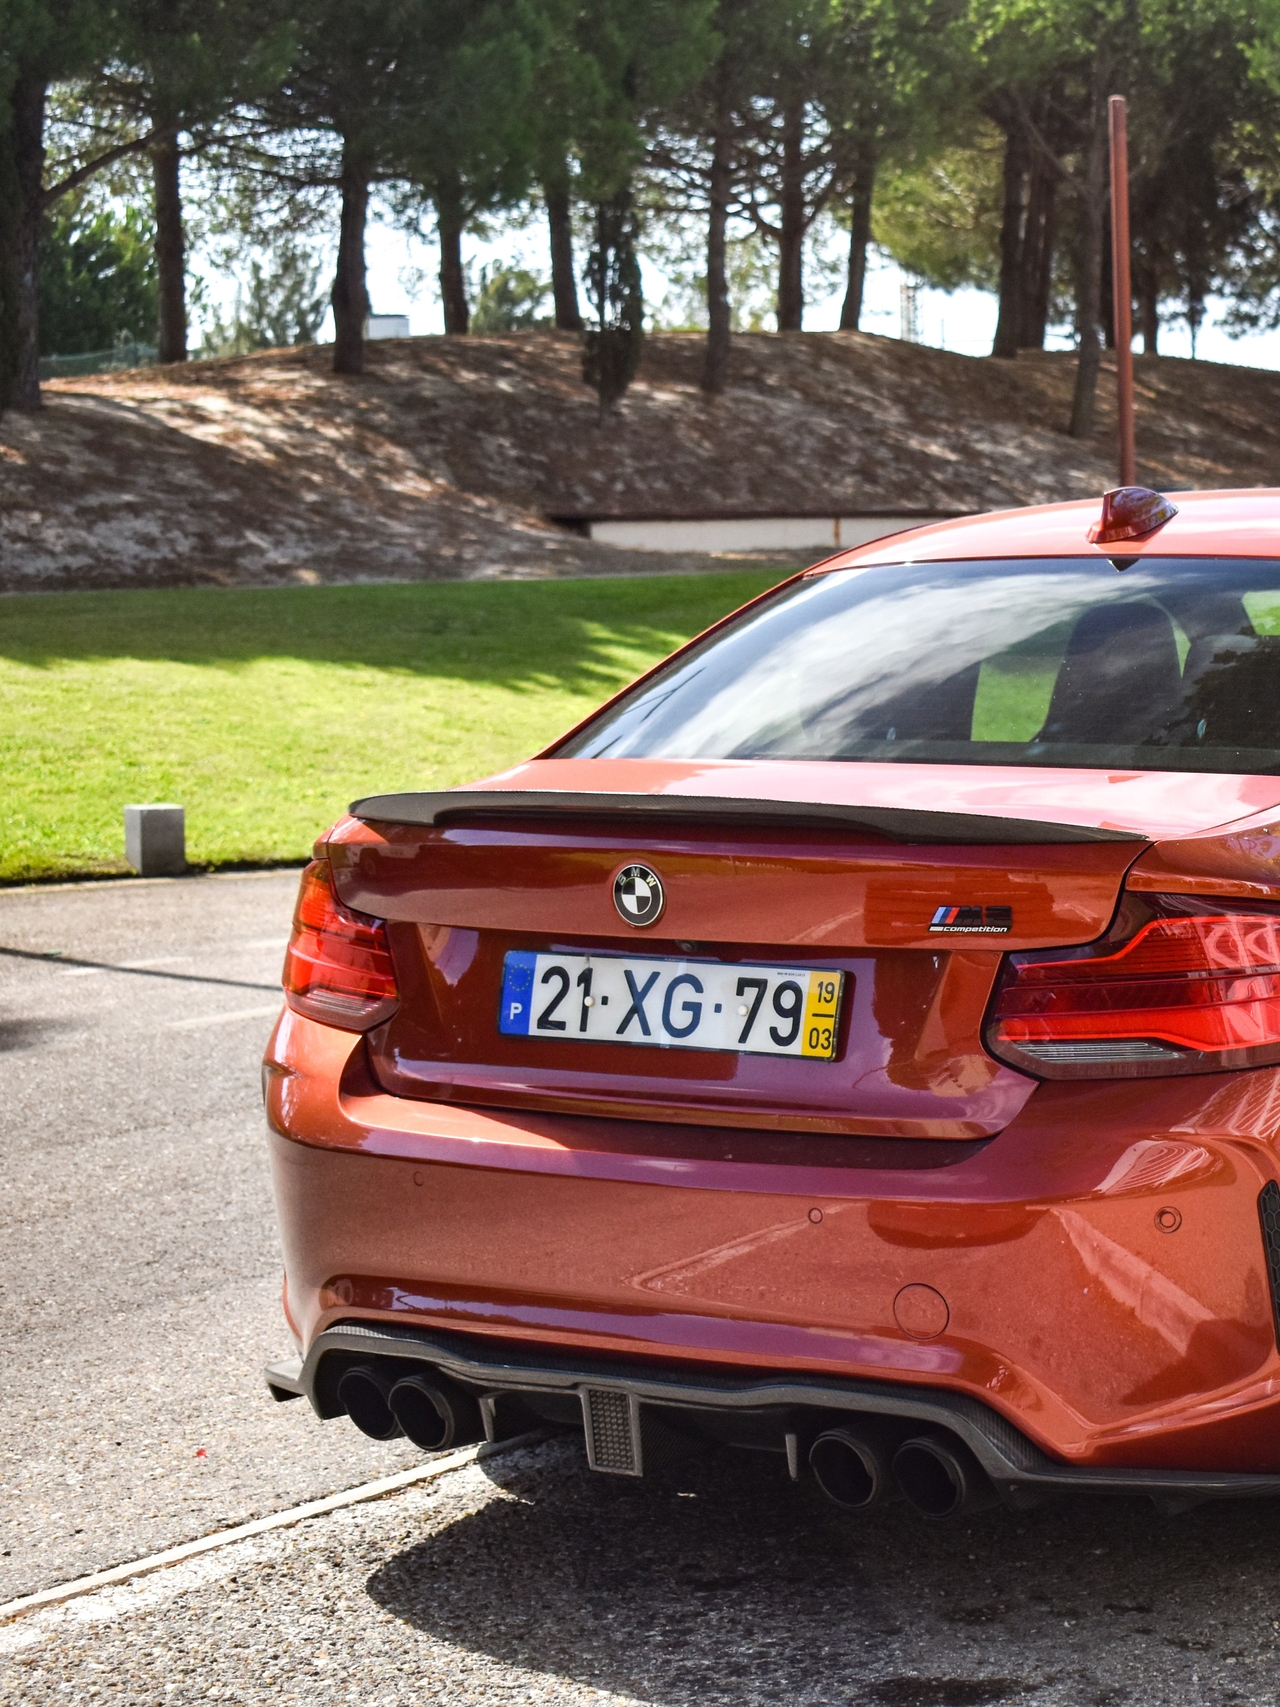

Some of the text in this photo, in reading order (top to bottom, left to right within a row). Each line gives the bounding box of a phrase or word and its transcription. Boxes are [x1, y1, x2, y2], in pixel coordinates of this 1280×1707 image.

[617, 866, 657, 888] BMW
[943, 925, 1008, 933] competition
[817, 981, 836, 1004] 19
[509, 1002, 523, 1020] P
[808, 1027, 832, 1051] 03
